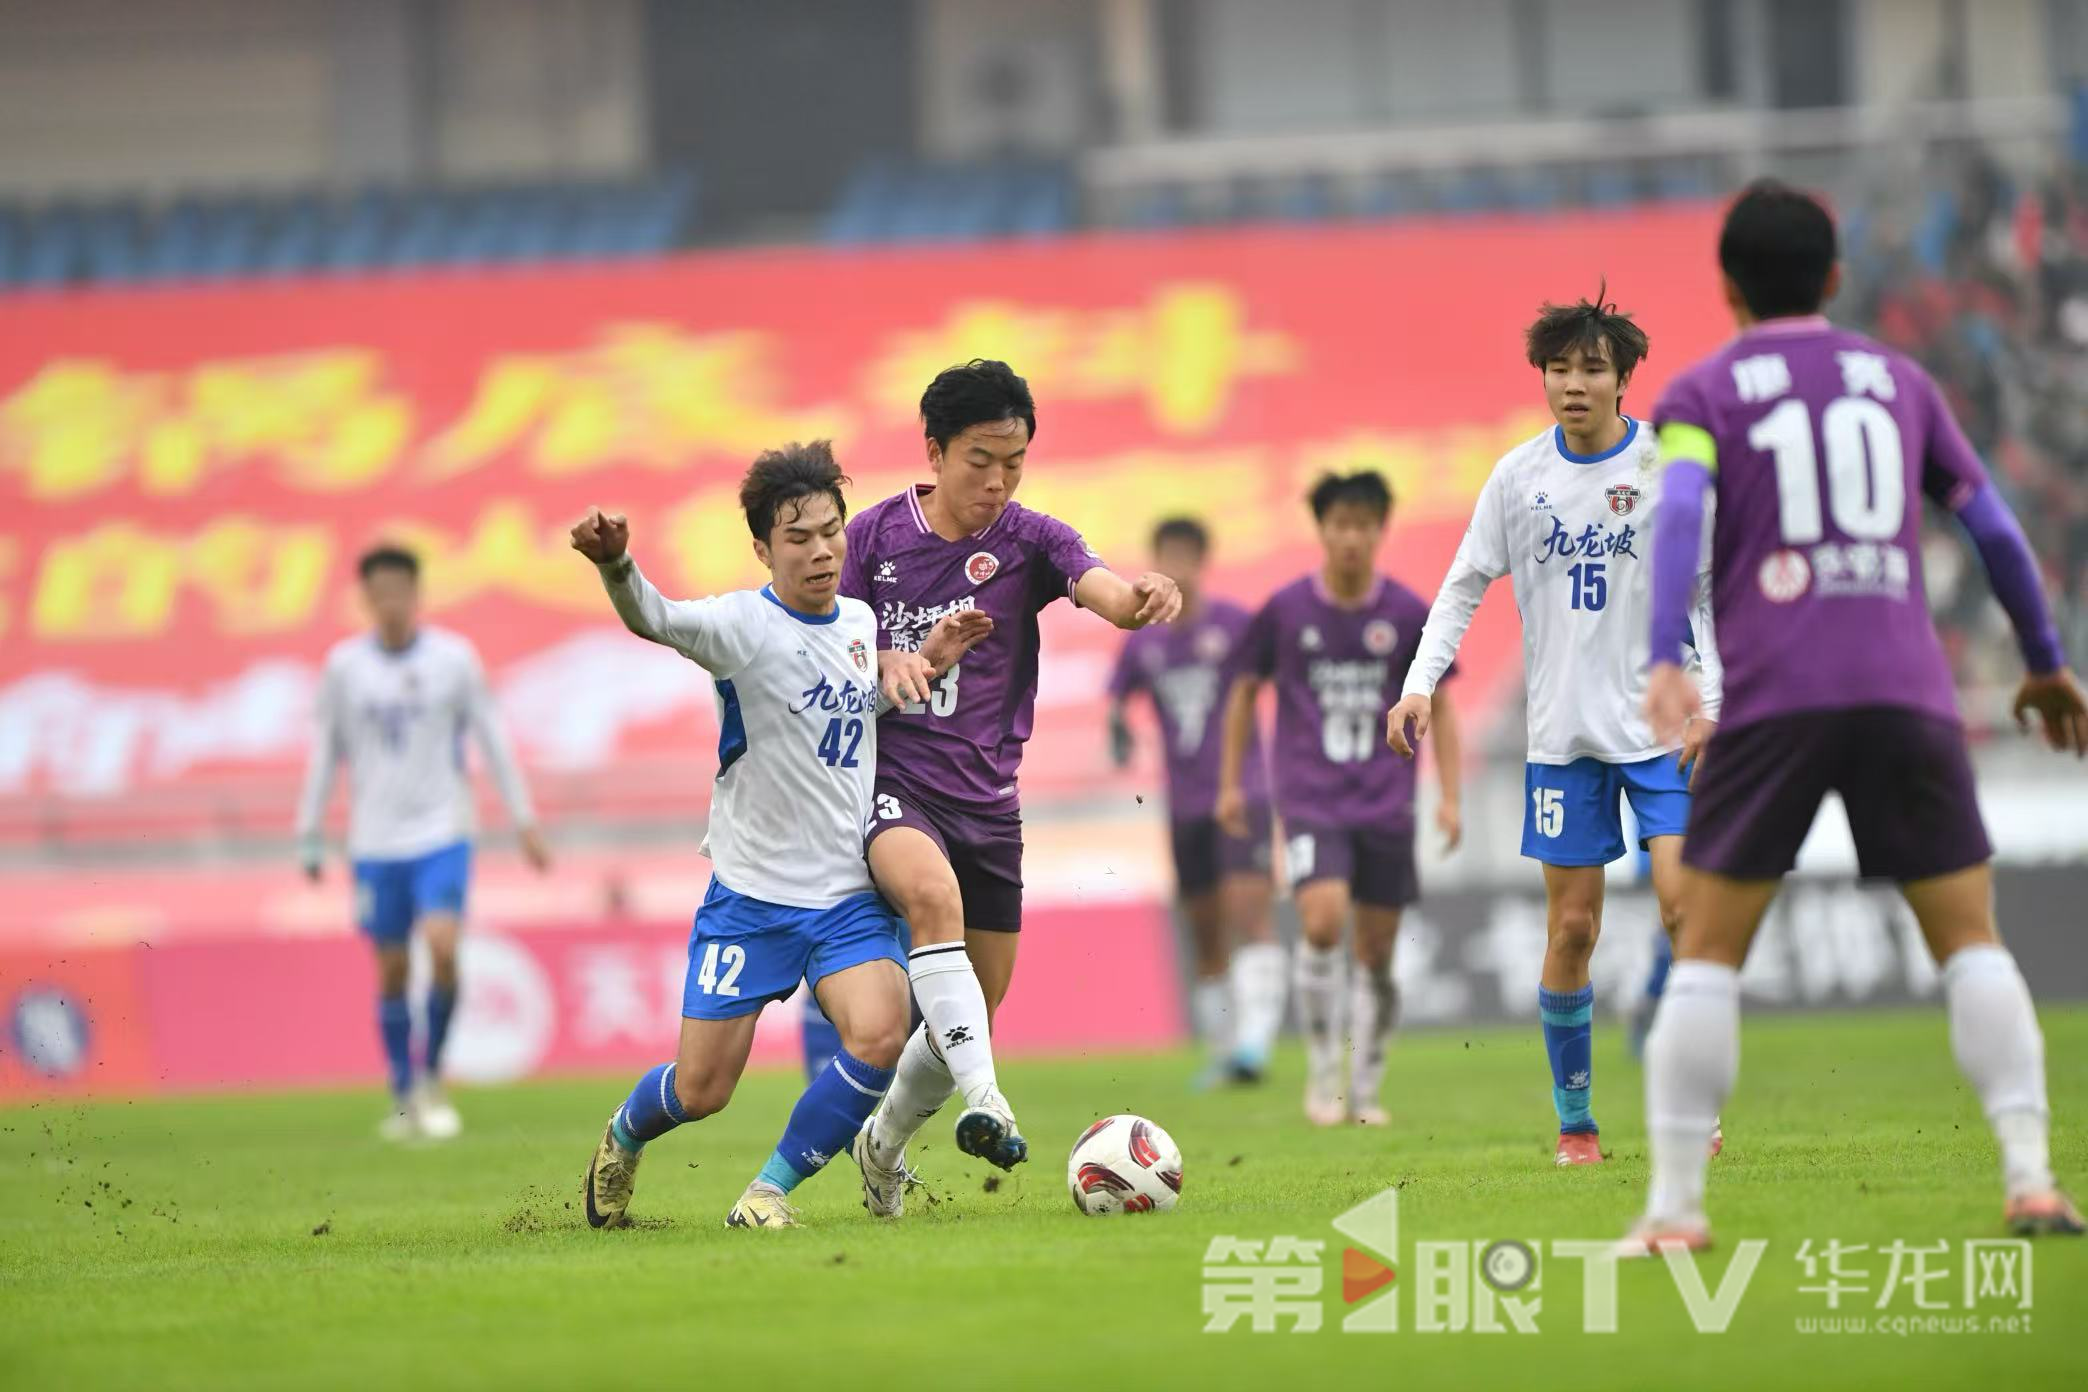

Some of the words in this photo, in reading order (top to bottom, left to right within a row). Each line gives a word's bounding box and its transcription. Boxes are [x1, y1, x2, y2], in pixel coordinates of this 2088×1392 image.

[1747, 398, 1905, 545] 10
[1535, 515, 1638, 564] 九龙坡
[874, 575, 898, 583] KELME
[1567, 563, 1607, 611] 15
[818, 718, 863, 768] 42
[1533, 787, 1564, 838] 15
[698, 943, 746, 997] 42
[945, 1035, 974, 1050] KELME
